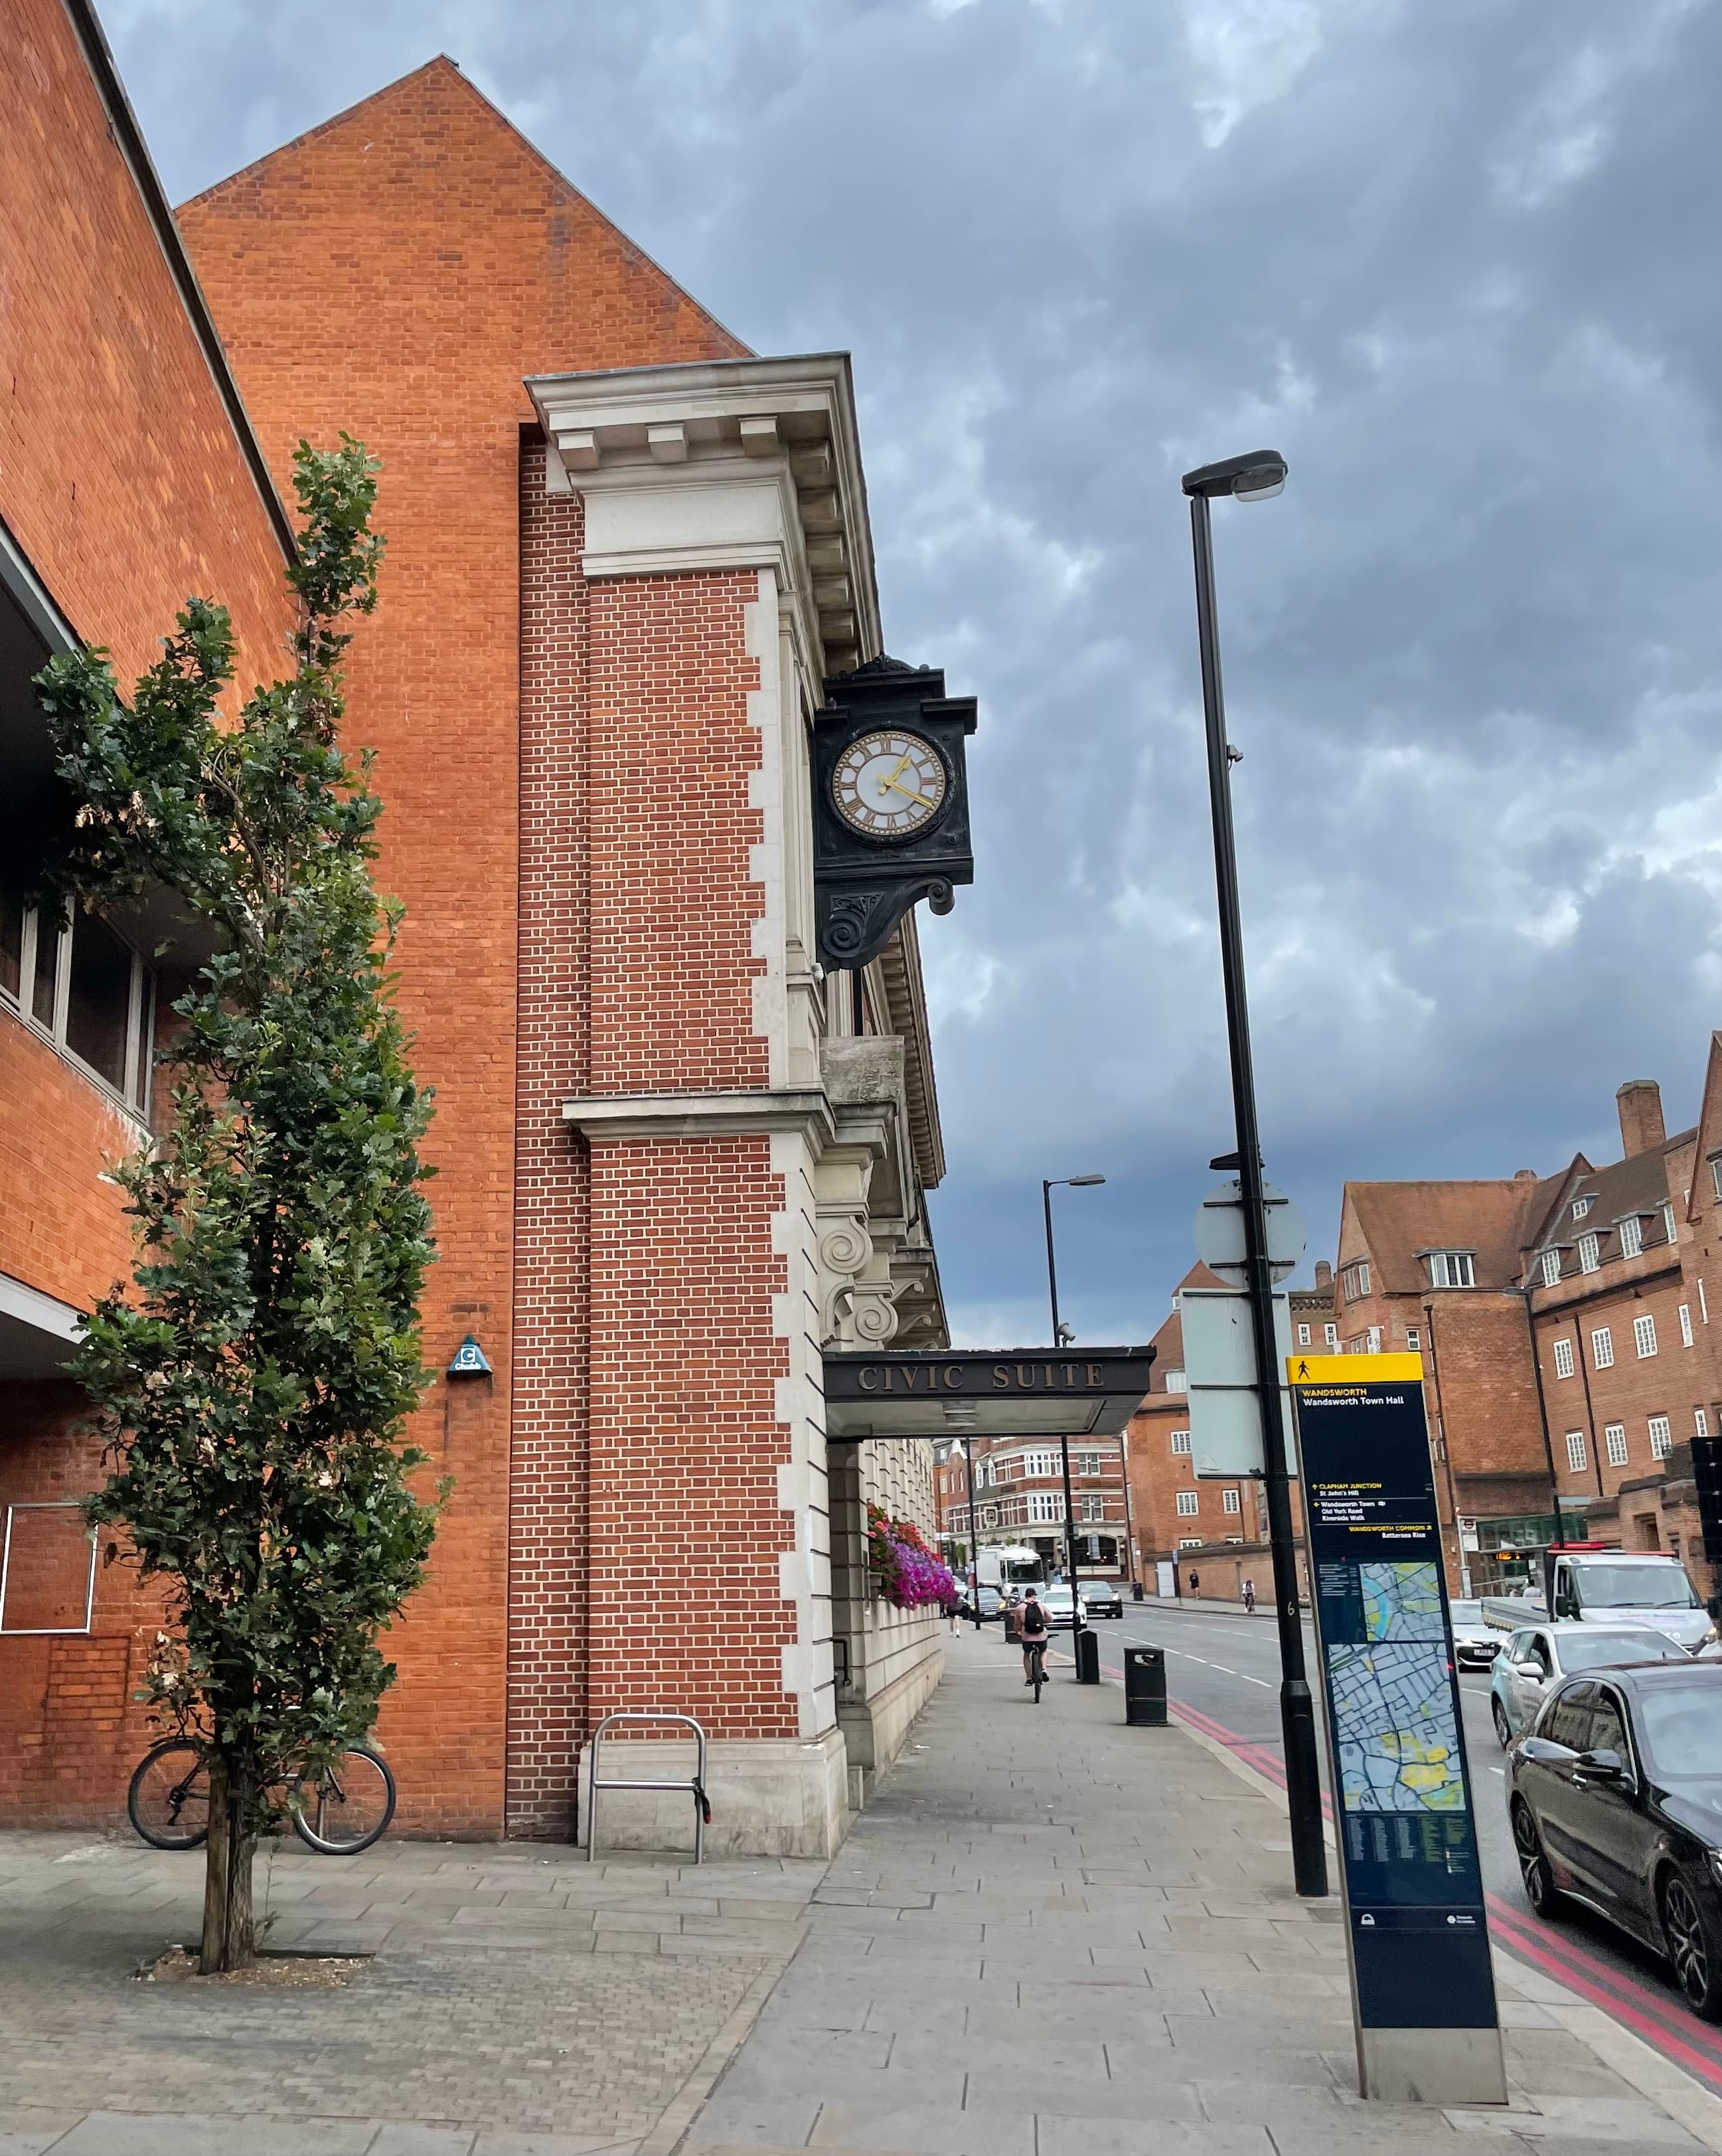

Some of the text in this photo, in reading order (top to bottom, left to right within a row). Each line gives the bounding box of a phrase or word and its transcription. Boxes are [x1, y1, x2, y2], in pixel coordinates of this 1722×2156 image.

[858, 1363, 1105, 1391] CIVIC SUITE
[1302, 1388, 1367, 1397] WANDSWORTH
[1303, 1397, 1359, 1406] Wandsworth
[1386, 1396, 1405, 1404] Hall
[1288, 1601, 1294, 1616] 6
